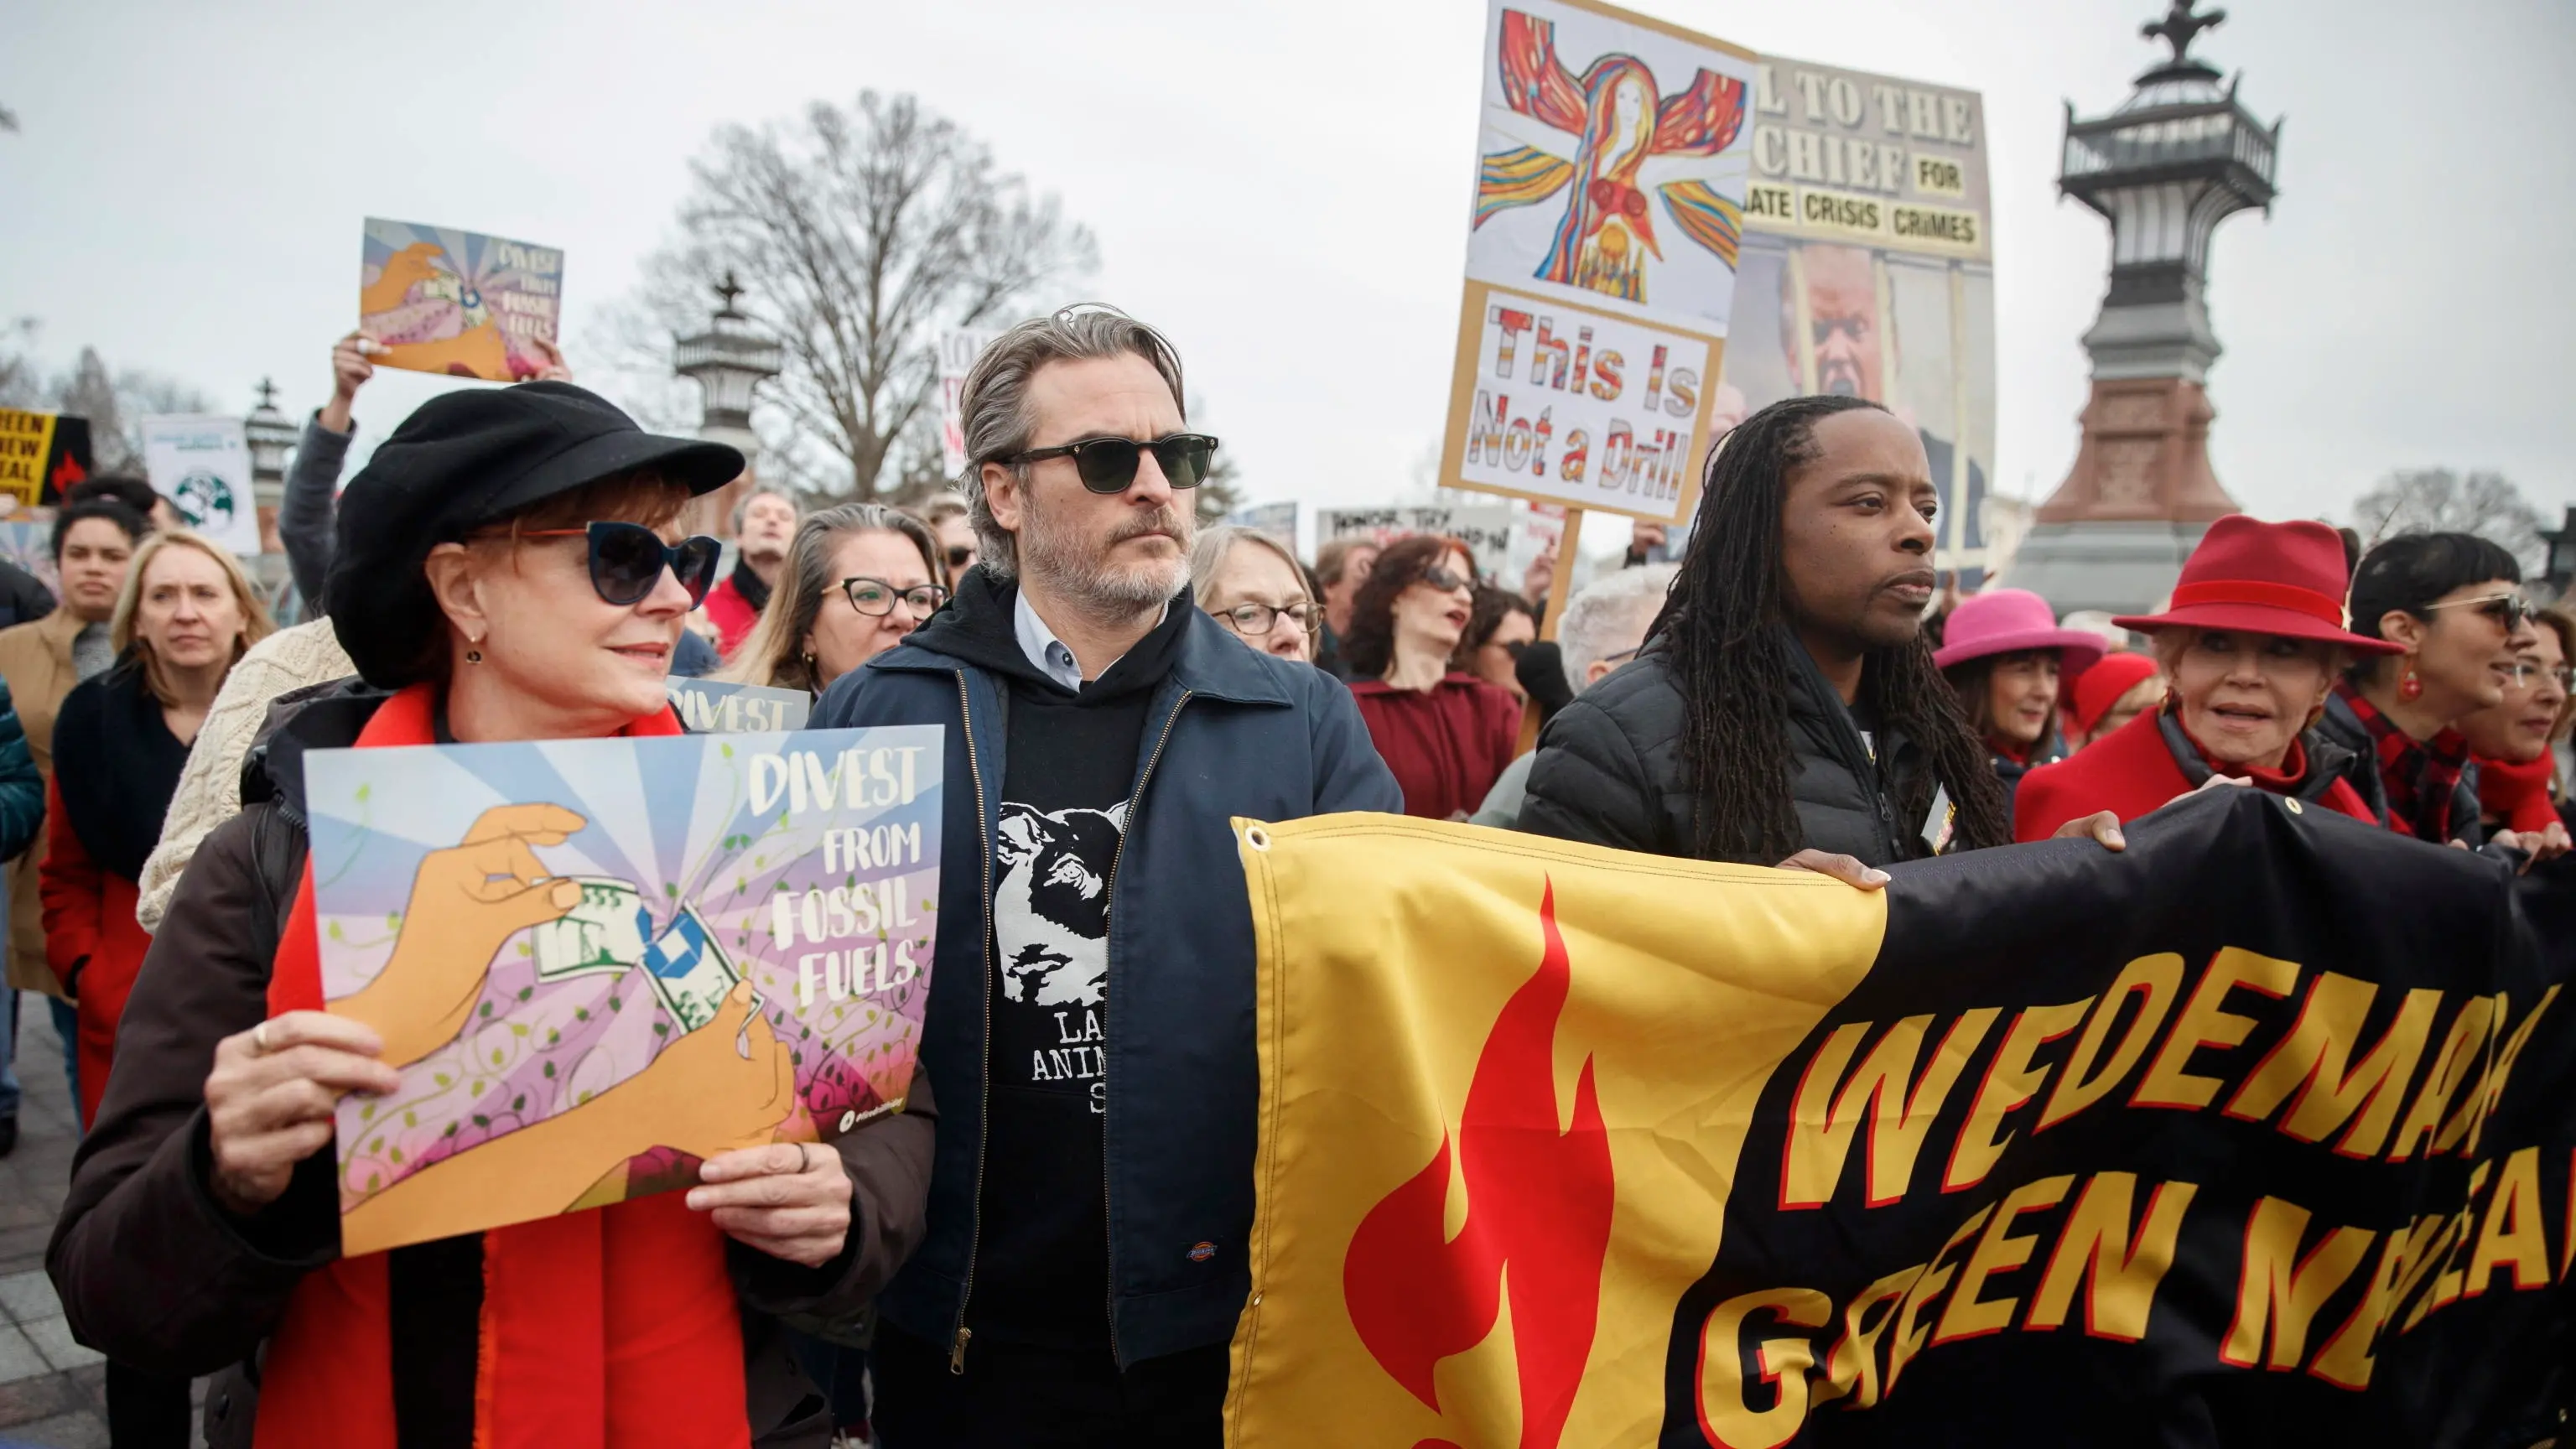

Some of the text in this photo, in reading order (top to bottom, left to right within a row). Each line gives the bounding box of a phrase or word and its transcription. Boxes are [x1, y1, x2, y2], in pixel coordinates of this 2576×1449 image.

[1794, 69, 1862, 127] TO
[1871, 81, 1974, 148] THE
[1754, 124, 1961, 195] CHIEF FOR
[1744, 188, 1793, 217] ATE
[1488, 304, 1698, 418] This Is
[1467, 389, 1690, 501] Not a Drill
[749, 746, 927, 818] DIVEST
[823, 821, 921, 875] FROM
[772, 875, 919, 951] FOSSIL
[798, 938, 917, 1008] FUELS
[1054, 1009, 1104, 1044] LA
[2033, 945, 2509, 1163] DEMA
[1695, 1170, 2199, 1449] GREEN
